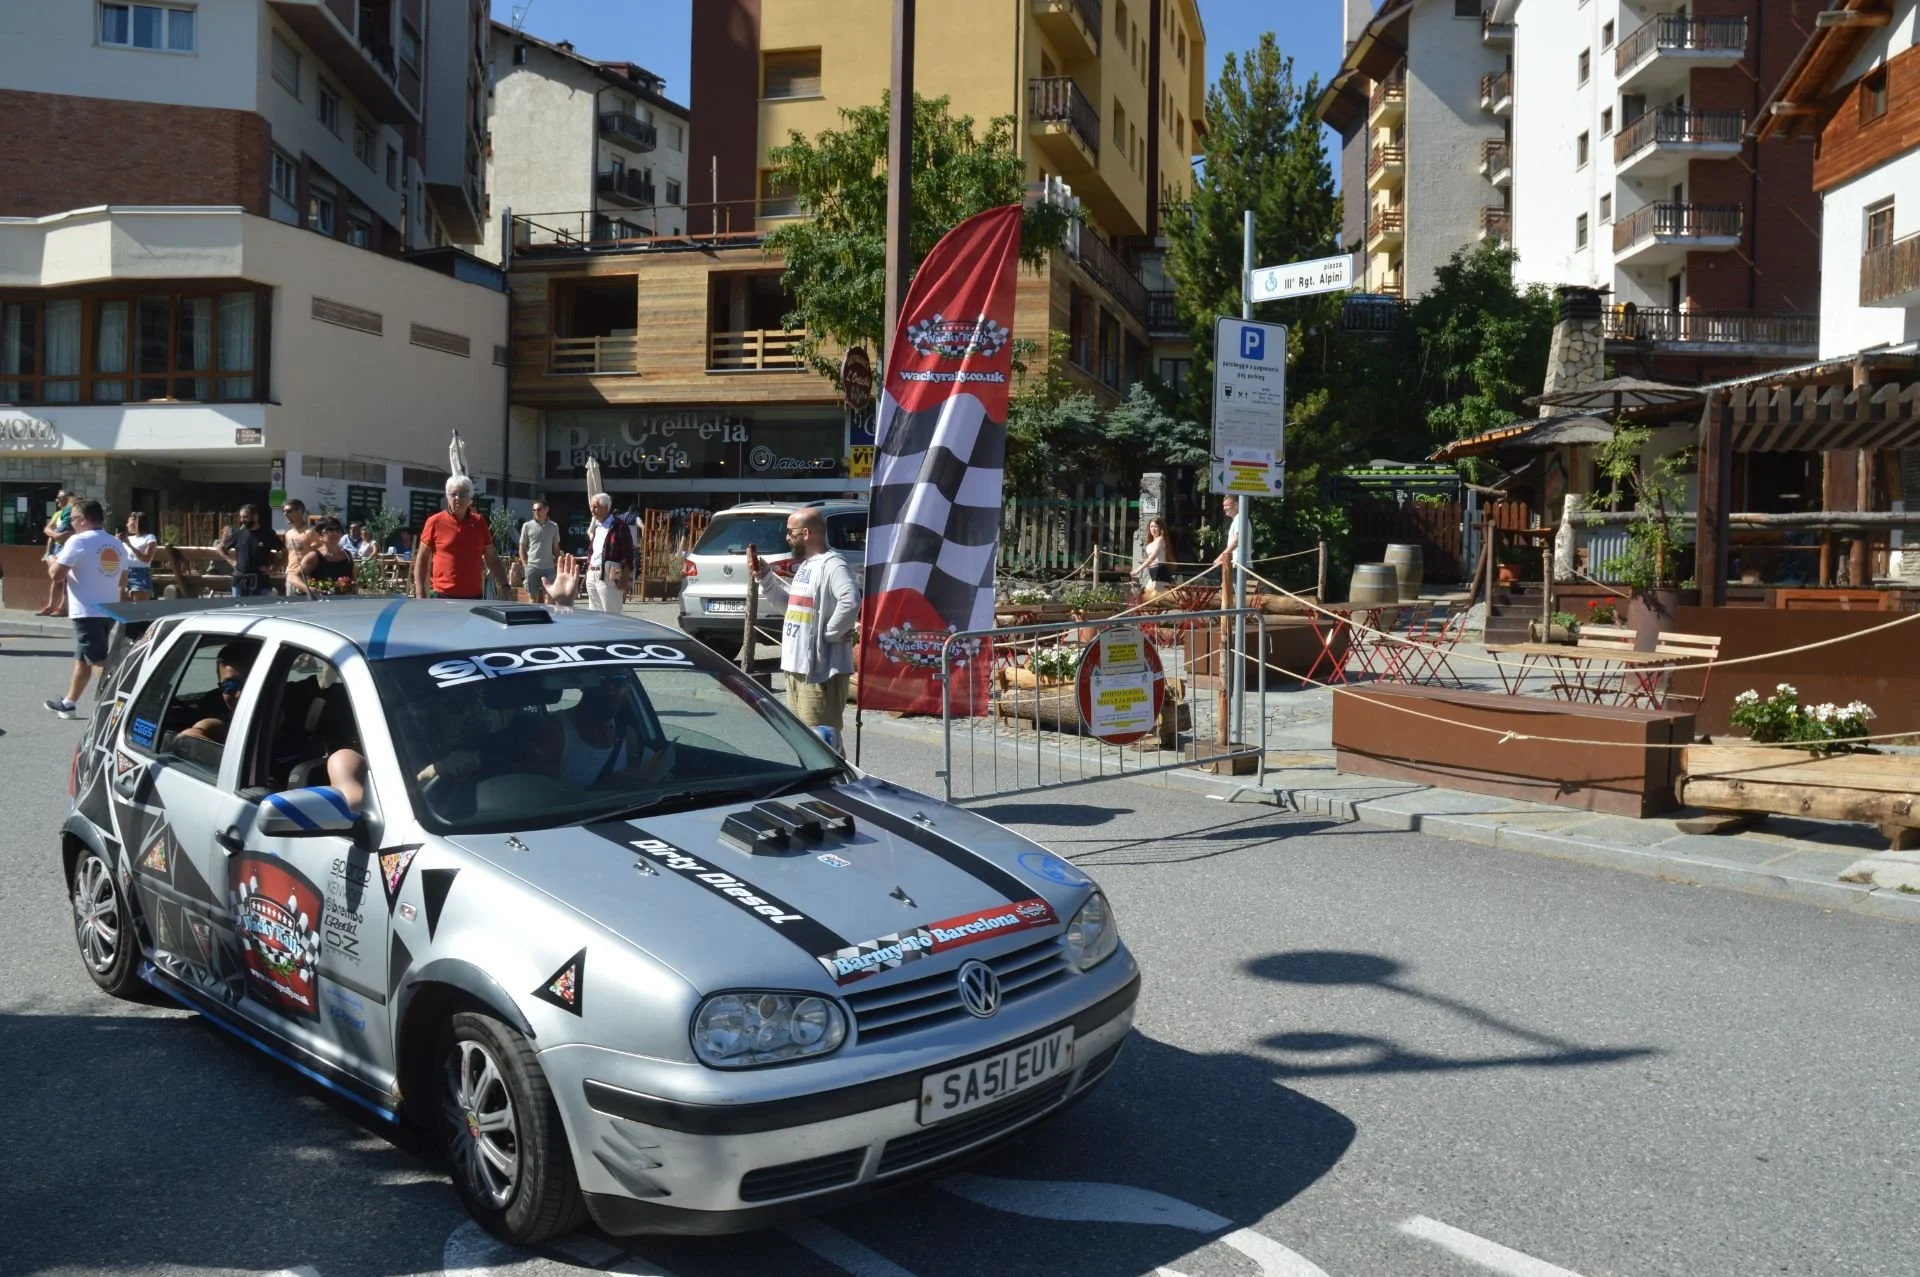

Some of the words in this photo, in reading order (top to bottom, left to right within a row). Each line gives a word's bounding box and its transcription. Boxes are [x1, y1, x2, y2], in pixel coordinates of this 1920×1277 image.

[1298, 276, 1315, 288] Rgt.
[1319, 271, 1343, 285] Alpini
[1323, 262, 1343, 271] piazza
[923, 331, 960, 344] Wacky
[900, 370, 1005, 383] wackyrally.co.uk
[1247, 373, 1265, 381] parking
[620, 411, 749, 446] Cremeria
[556, 426, 691, 473] Pasticceria
[428, 643, 687, 680] sparco
[895, 641, 930, 653] Wacky
[932, 641, 961, 656] Rlly
[331, 858, 371, 885] sparco
[629, 839, 709, 871] Dirty
[696, 872, 804, 924] Diesel
[331, 898, 364, 924] brembo
[242, 914, 274, 941] Wacky
[274, 925, 304, 960] Rally
[831, 941, 904, 976] Barmy
[899, 934, 934, 952] To
[930, 912, 1020, 944] Barcelona
[943, 1057, 1008, 1110] SA51
[1014, 1035, 1062, 1086] EUV
